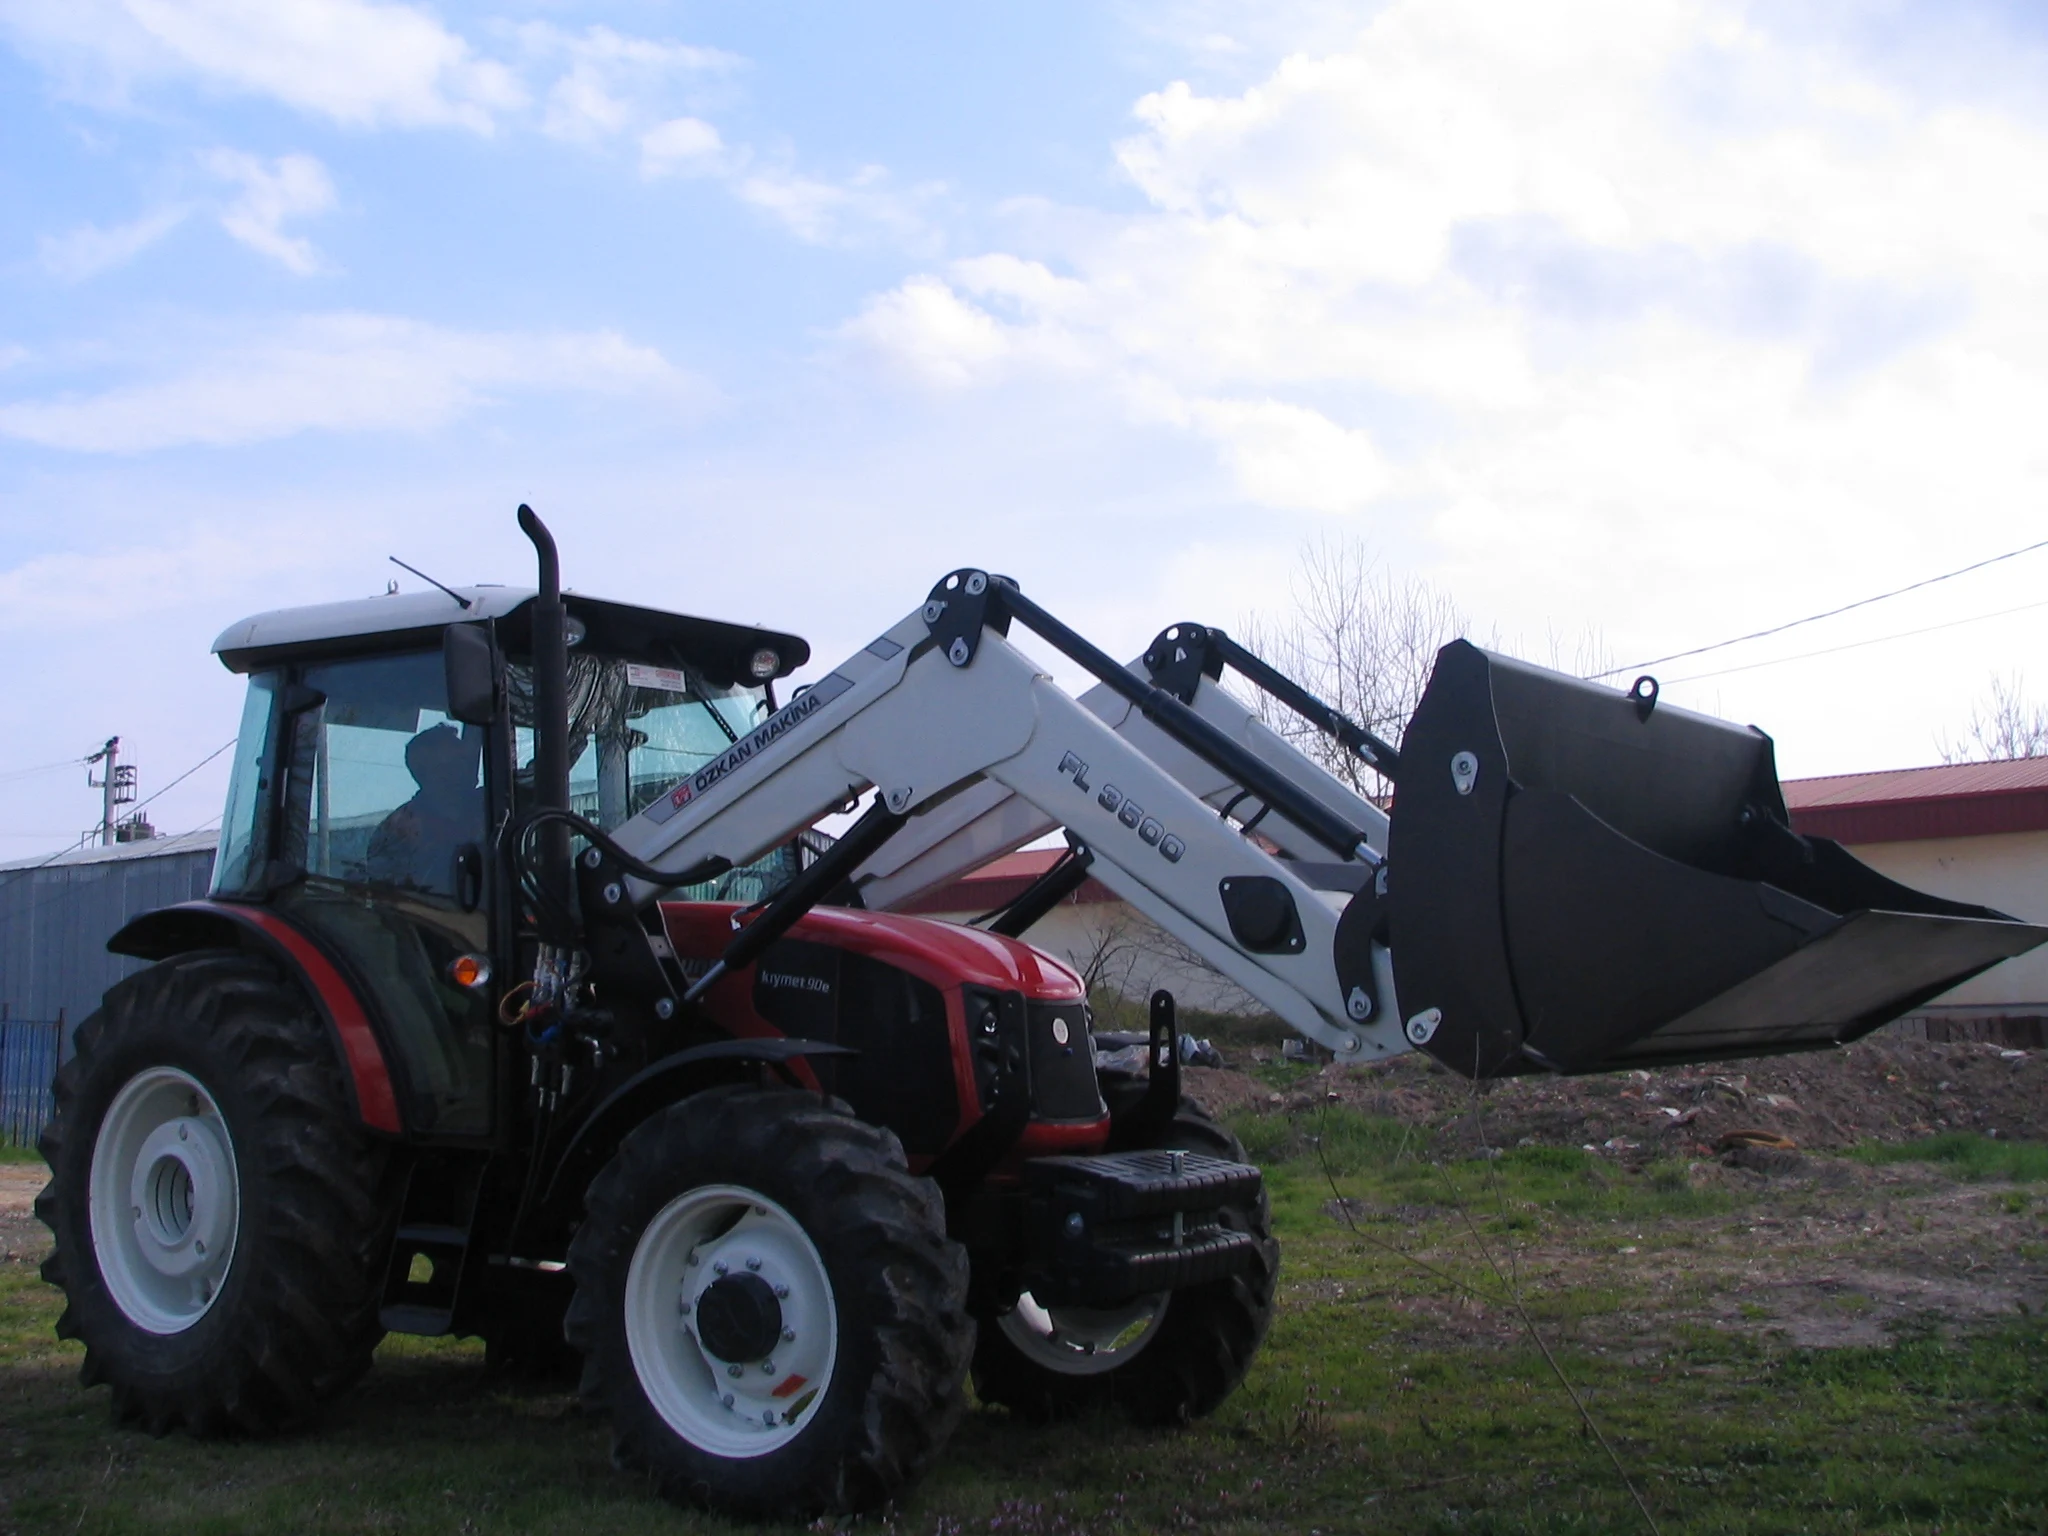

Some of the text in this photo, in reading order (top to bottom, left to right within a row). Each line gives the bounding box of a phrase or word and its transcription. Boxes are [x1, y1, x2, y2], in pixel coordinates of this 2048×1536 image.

[695, 695, 821, 791] ÖZKAN MAKİNA
[1057, 750, 1090, 794] FL
